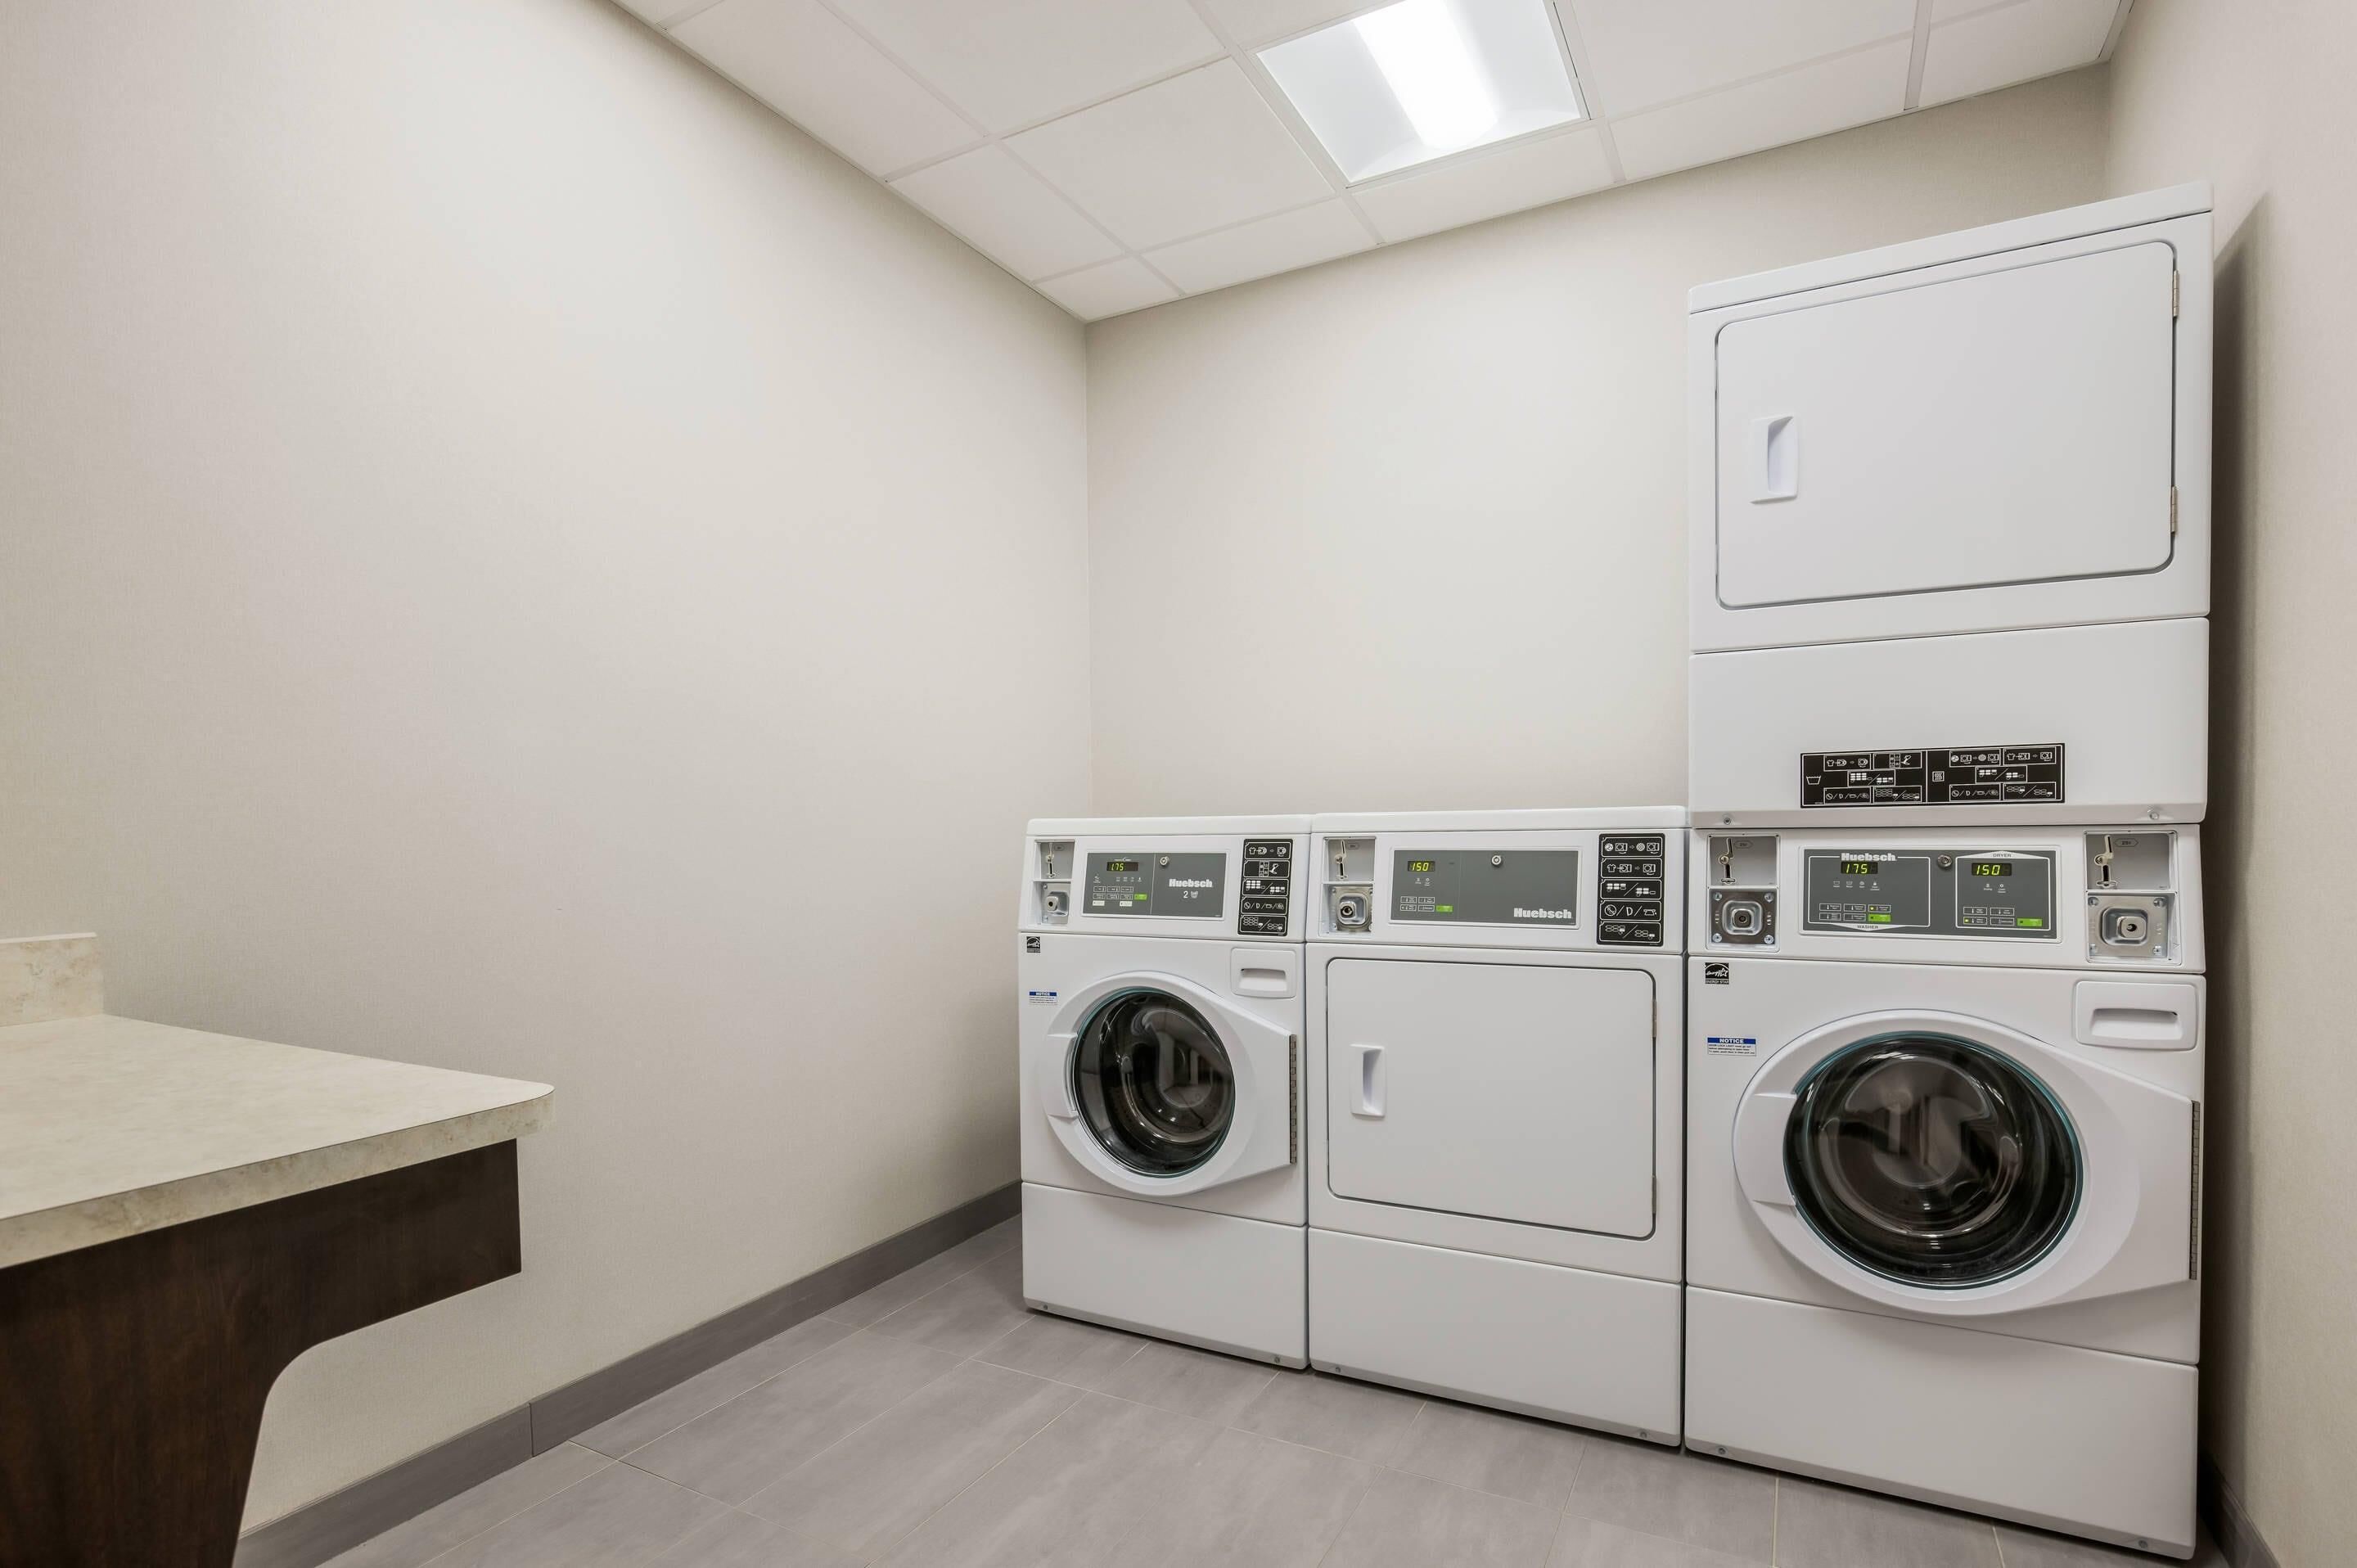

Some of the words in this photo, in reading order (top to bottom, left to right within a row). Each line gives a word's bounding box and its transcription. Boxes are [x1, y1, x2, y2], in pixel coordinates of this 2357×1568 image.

[1841, 853, 1896, 862] Huebsch
[1111, 863, 1124, 871] 175
[1412, 863, 1429, 872] 150
[1846, 863, 1868, 874] 175
[1976, 864, 2000, 875] 150
[1169, 879, 1213, 888] Huebsch
[1183, 890, 1188, 899] 2
[1513, 908, 1572, 919] Huebsch
